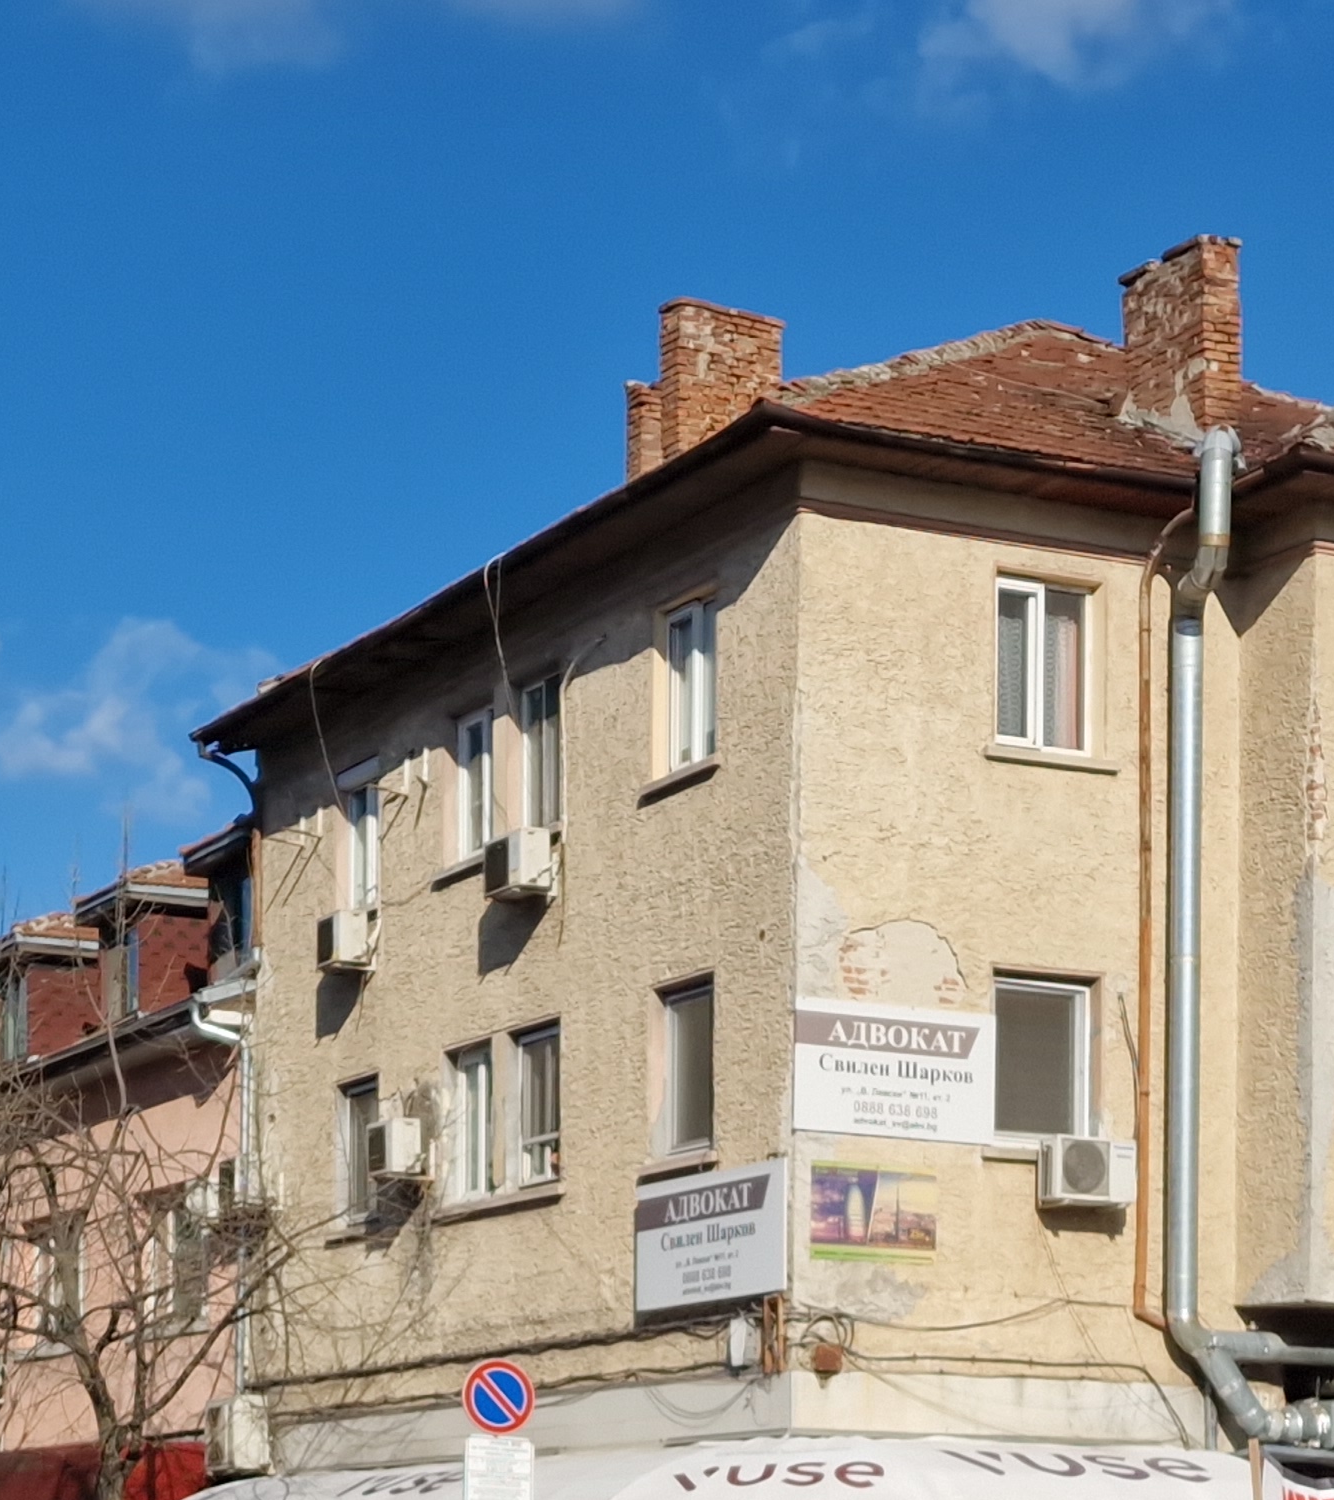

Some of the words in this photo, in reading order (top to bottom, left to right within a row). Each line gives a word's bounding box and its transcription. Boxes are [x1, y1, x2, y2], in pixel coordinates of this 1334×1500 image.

[828, 1019, 966, 1053] АДВОКАТ
[819, 1053, 890, 1077] Свилен
[897, 1060, 974, 1085] Шарков
[664, 1182, 753, 1224] АДВОКАТ
[661, 1230, 703, 1251] Свилен
[707, 1222, 756, 1246] Шарков
